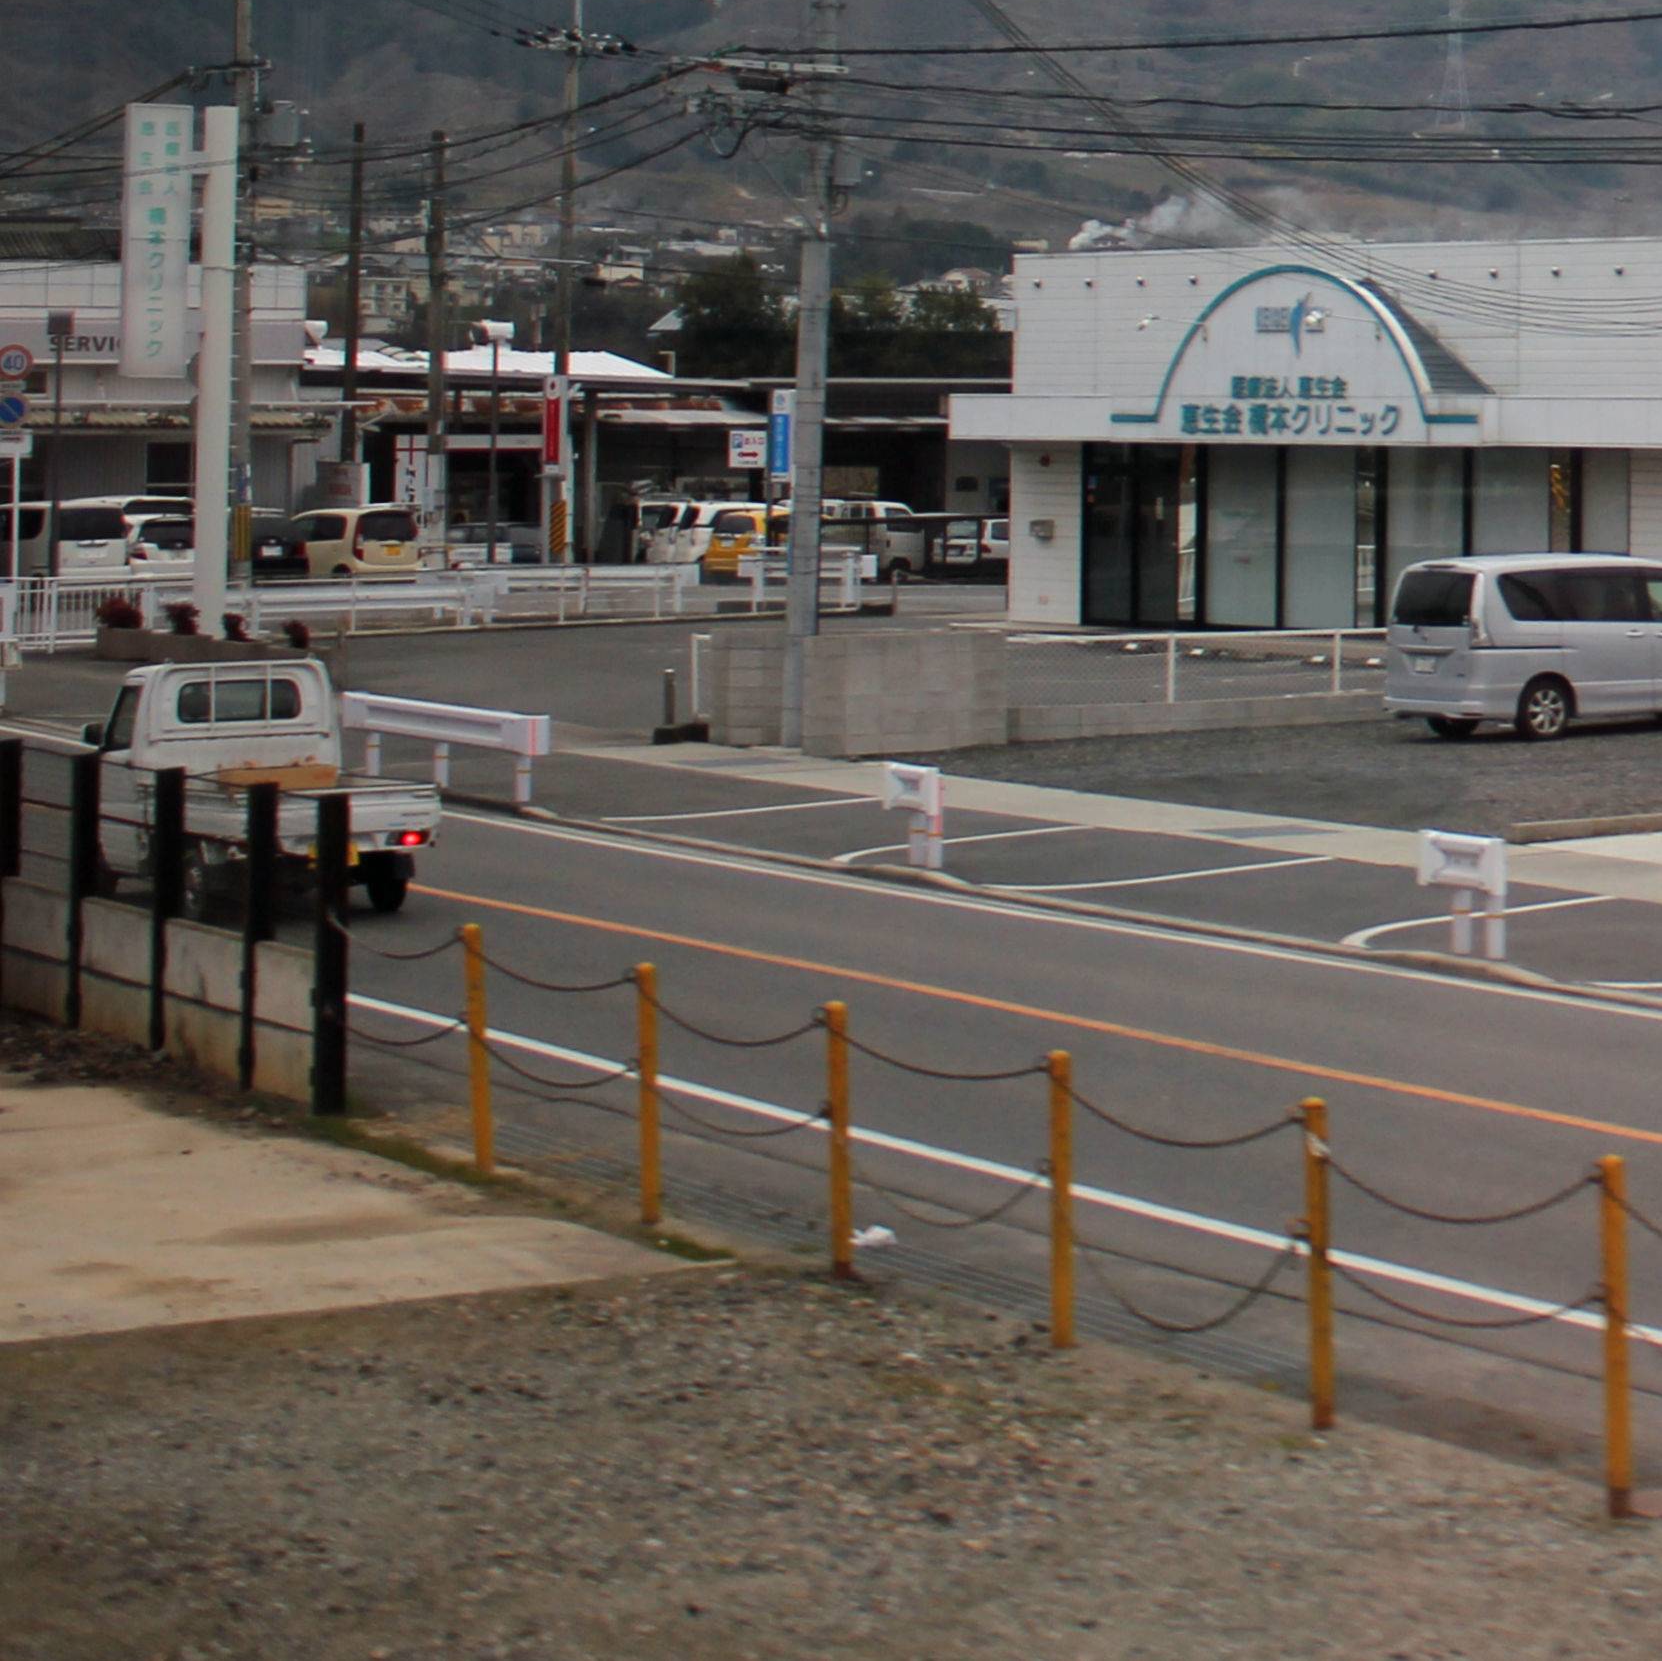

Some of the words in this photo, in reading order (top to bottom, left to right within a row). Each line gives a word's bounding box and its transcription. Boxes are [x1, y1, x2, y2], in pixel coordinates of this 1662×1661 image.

[3, 354, 24, 371] 40
[1231, 375, 1295, 400] 医療法人
[1248, 403, 1402, 436] 橋本クリニック
